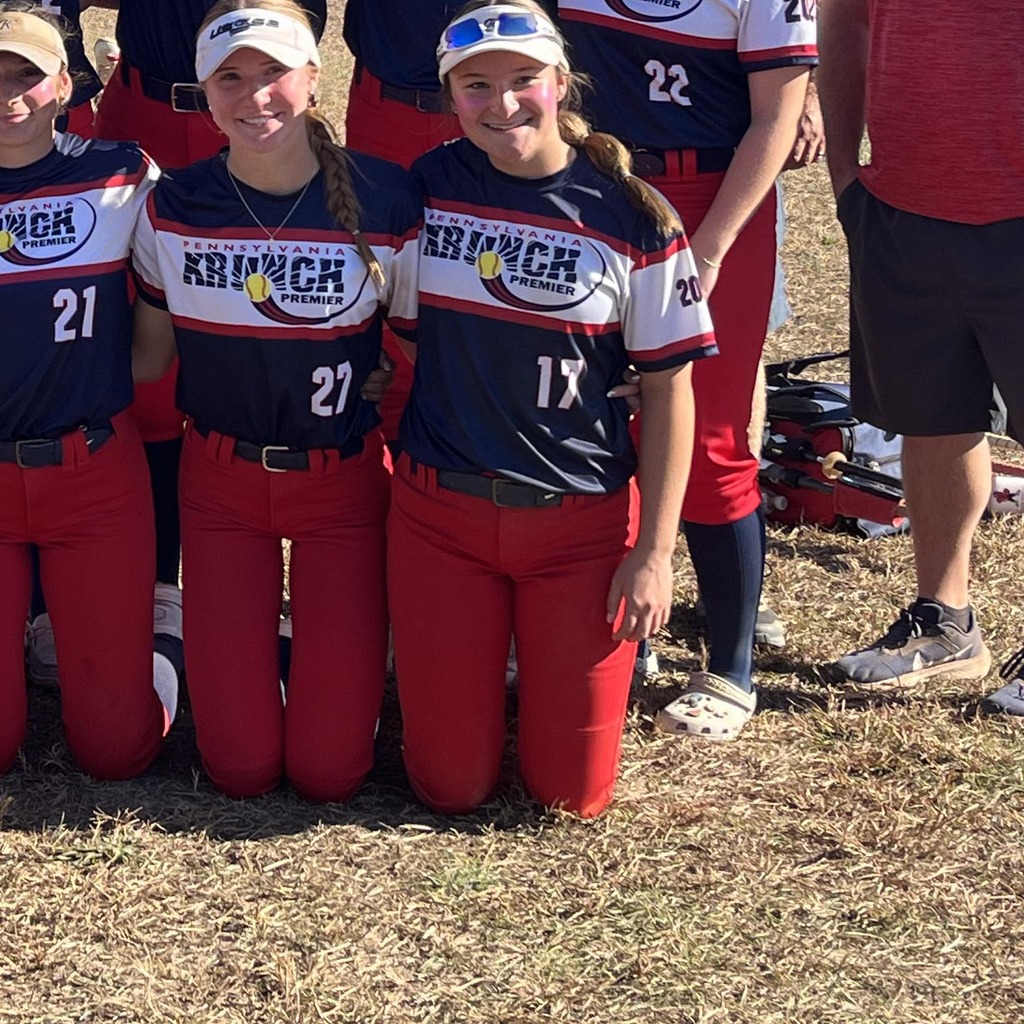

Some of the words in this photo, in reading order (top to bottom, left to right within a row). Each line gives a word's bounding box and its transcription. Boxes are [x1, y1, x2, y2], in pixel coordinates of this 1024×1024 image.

[644, 59, 693, 107] 22
[22, 236, 77, 249] PREMIER
[183, 241, 346, 256] PENNSYLVANIA
[428, 213, 583, 246] PENNSYLVANIA
[182, 251, 346, 293] KRUNCH
[423, 222, 581, 284] KRUNCH
[281, 293, 344, 306] PREMIER
[509, 275, 576, 296] PREMIER
[53, 285, 97, 342] 21
[311, 360, 353, 416] 27
[537, 355, 585, 410] 17
